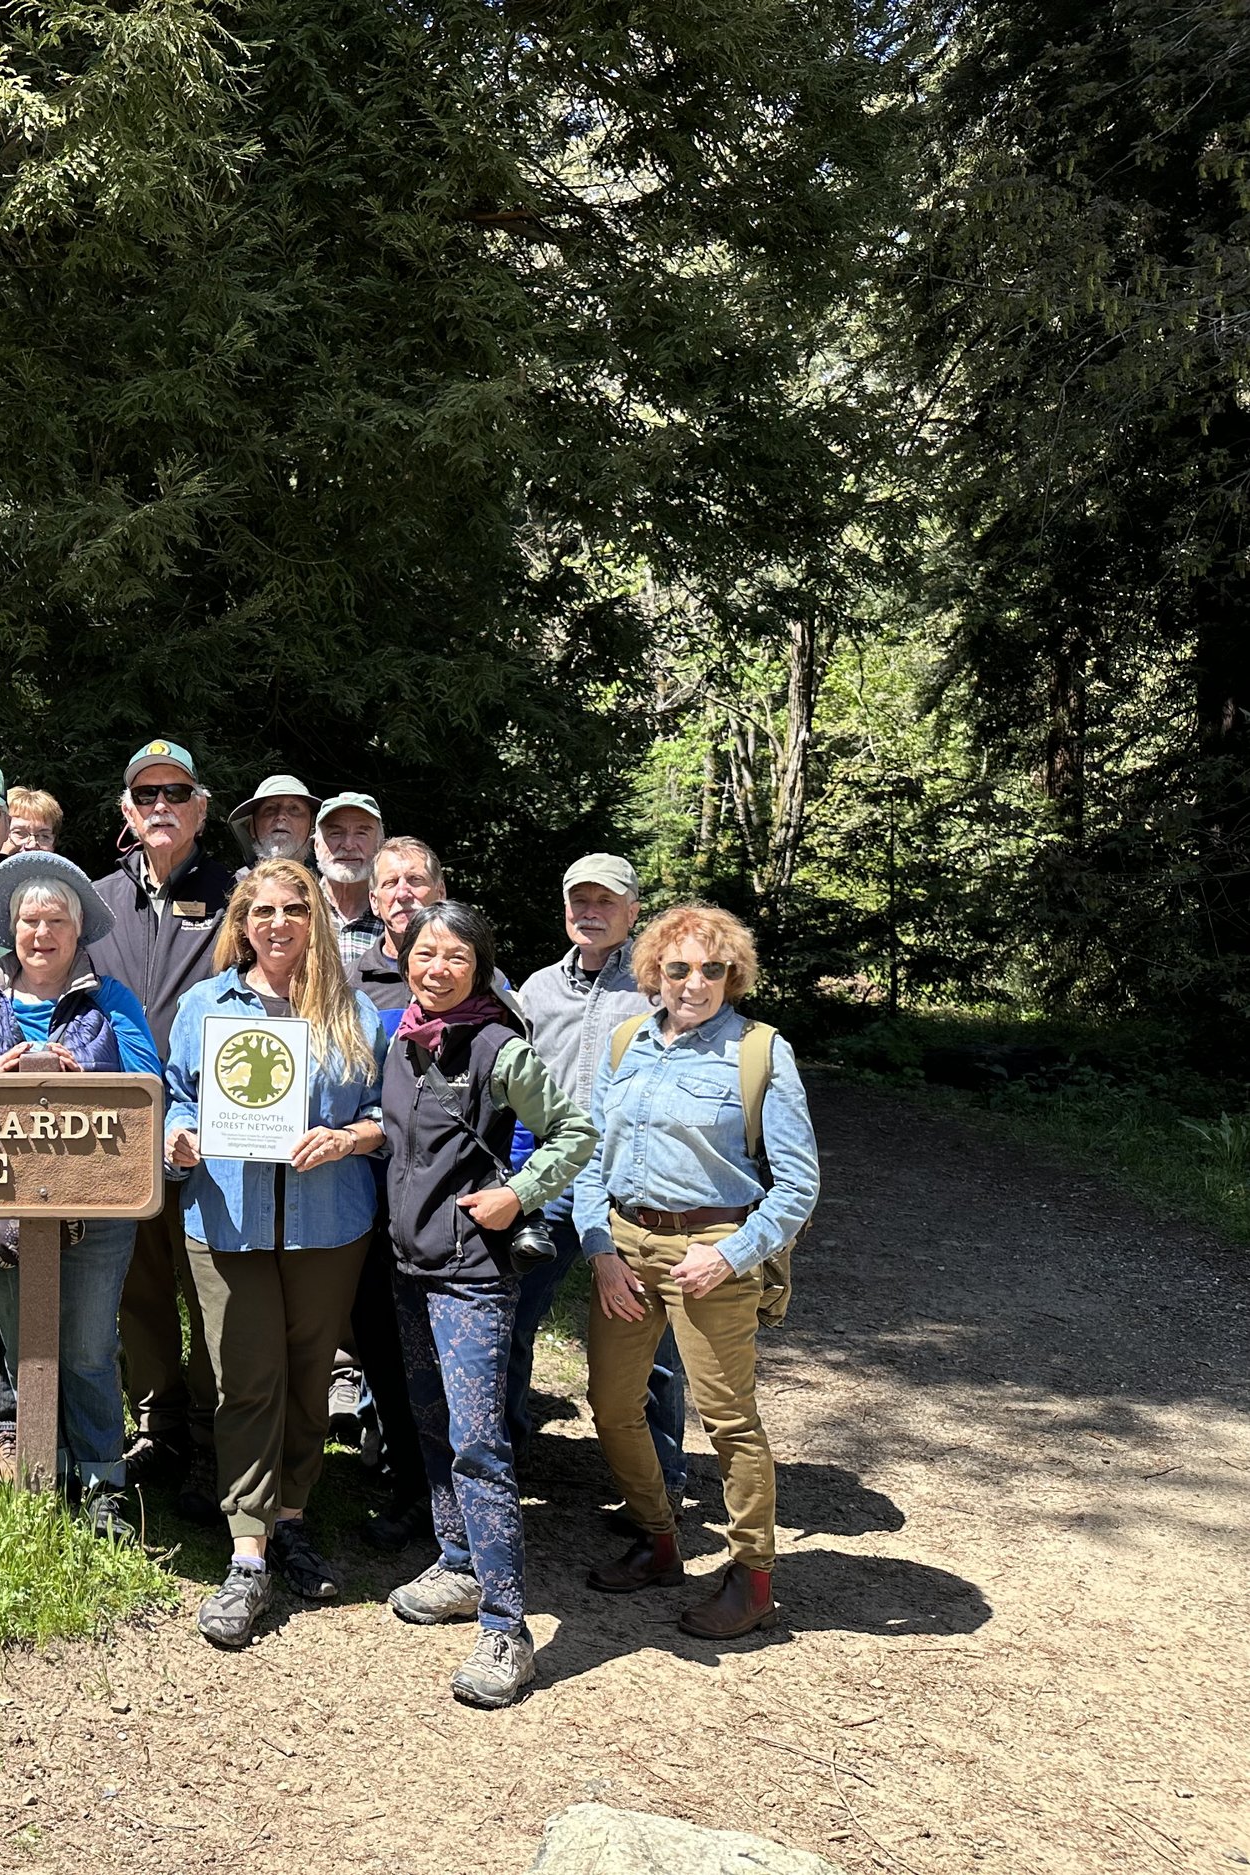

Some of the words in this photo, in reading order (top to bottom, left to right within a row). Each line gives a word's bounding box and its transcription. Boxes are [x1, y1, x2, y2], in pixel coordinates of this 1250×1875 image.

[219, 1112, 284, 1122] OLD-GROWTH
[211, 1121, 245, 1130] FOREST
[247, 1123, 295, 1133] NETWORK
